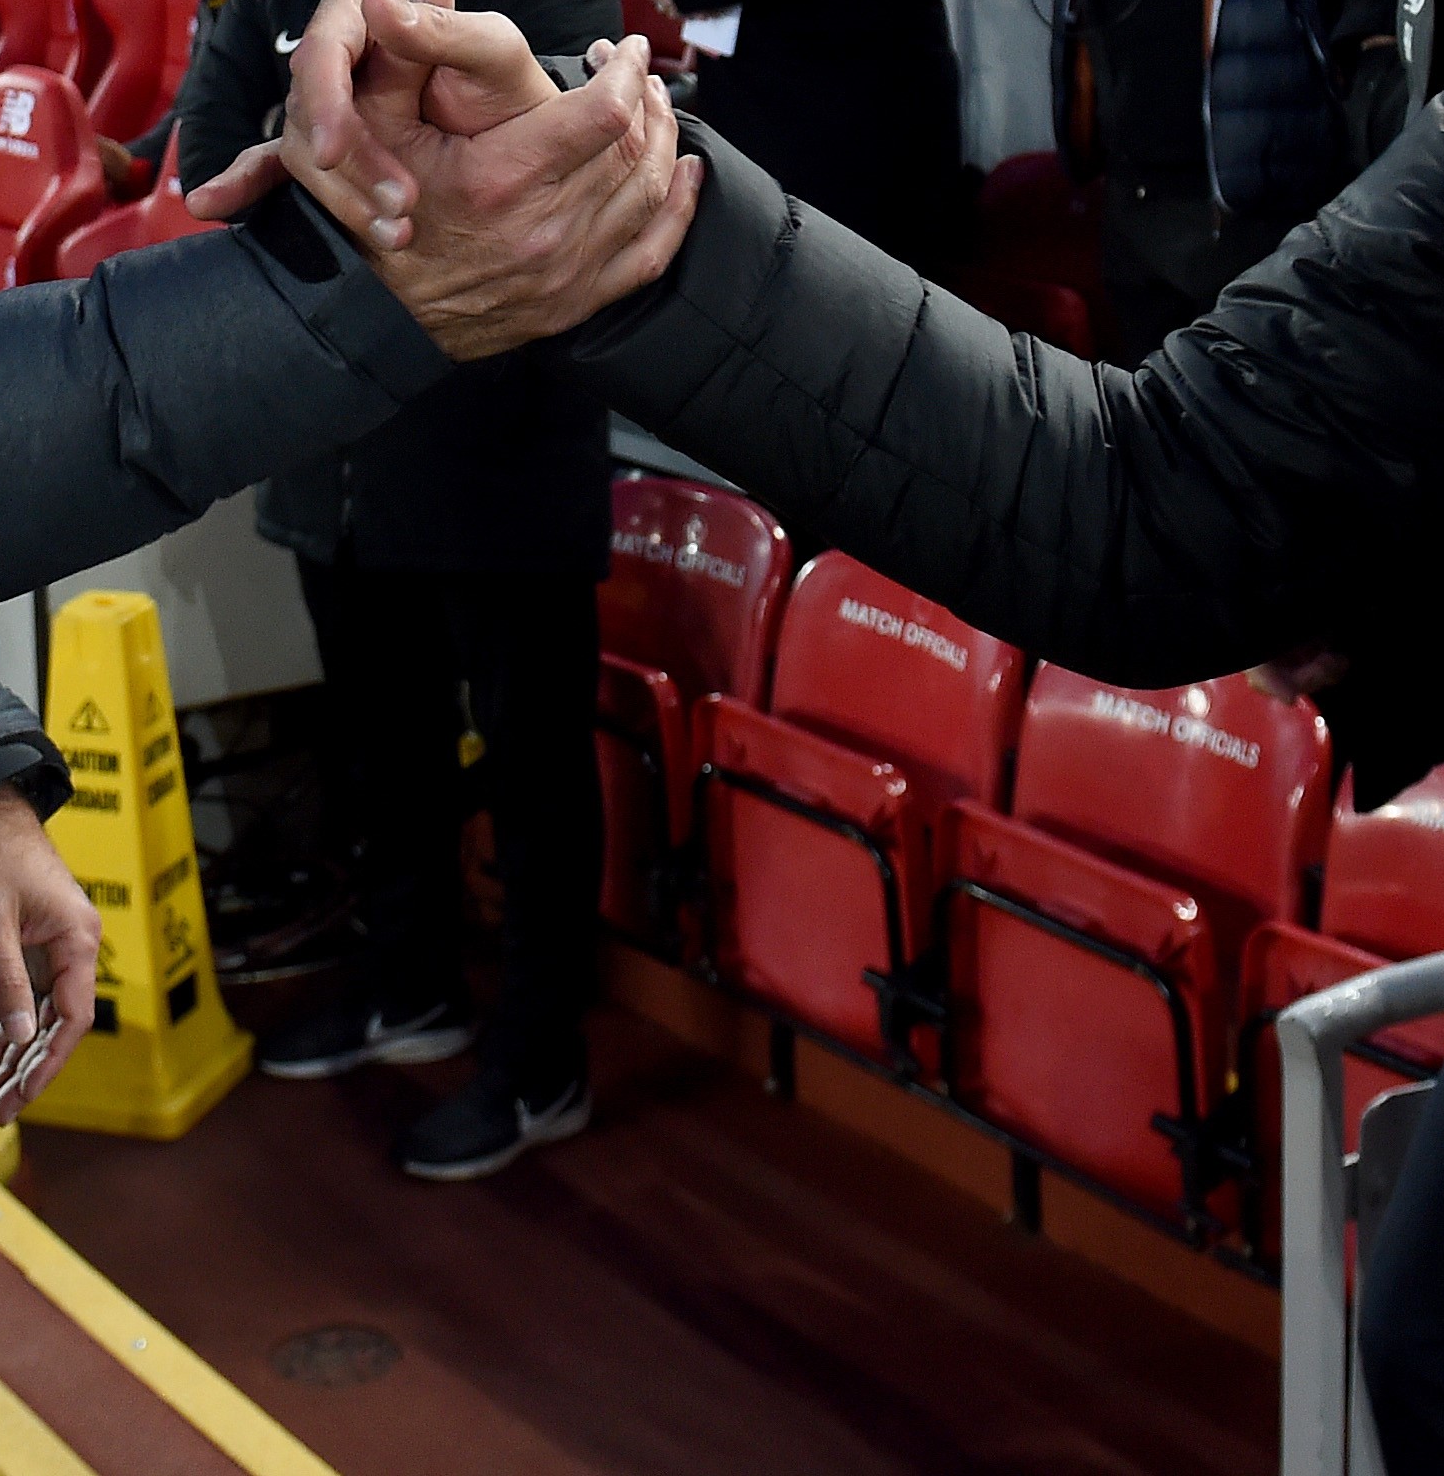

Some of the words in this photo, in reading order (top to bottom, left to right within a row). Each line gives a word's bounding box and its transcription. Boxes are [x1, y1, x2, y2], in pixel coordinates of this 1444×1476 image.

[611, 531, 674, 564] MATCH
[674, 545, 747, 588] OFFICIALS
[840, 596, 904, 640] MATCH
[902, 621, 968, 673] OFFICIALS
[1093, 690, 1170, 735] MATCH
[1170, 715, 1261, 769] OFFICIALS
